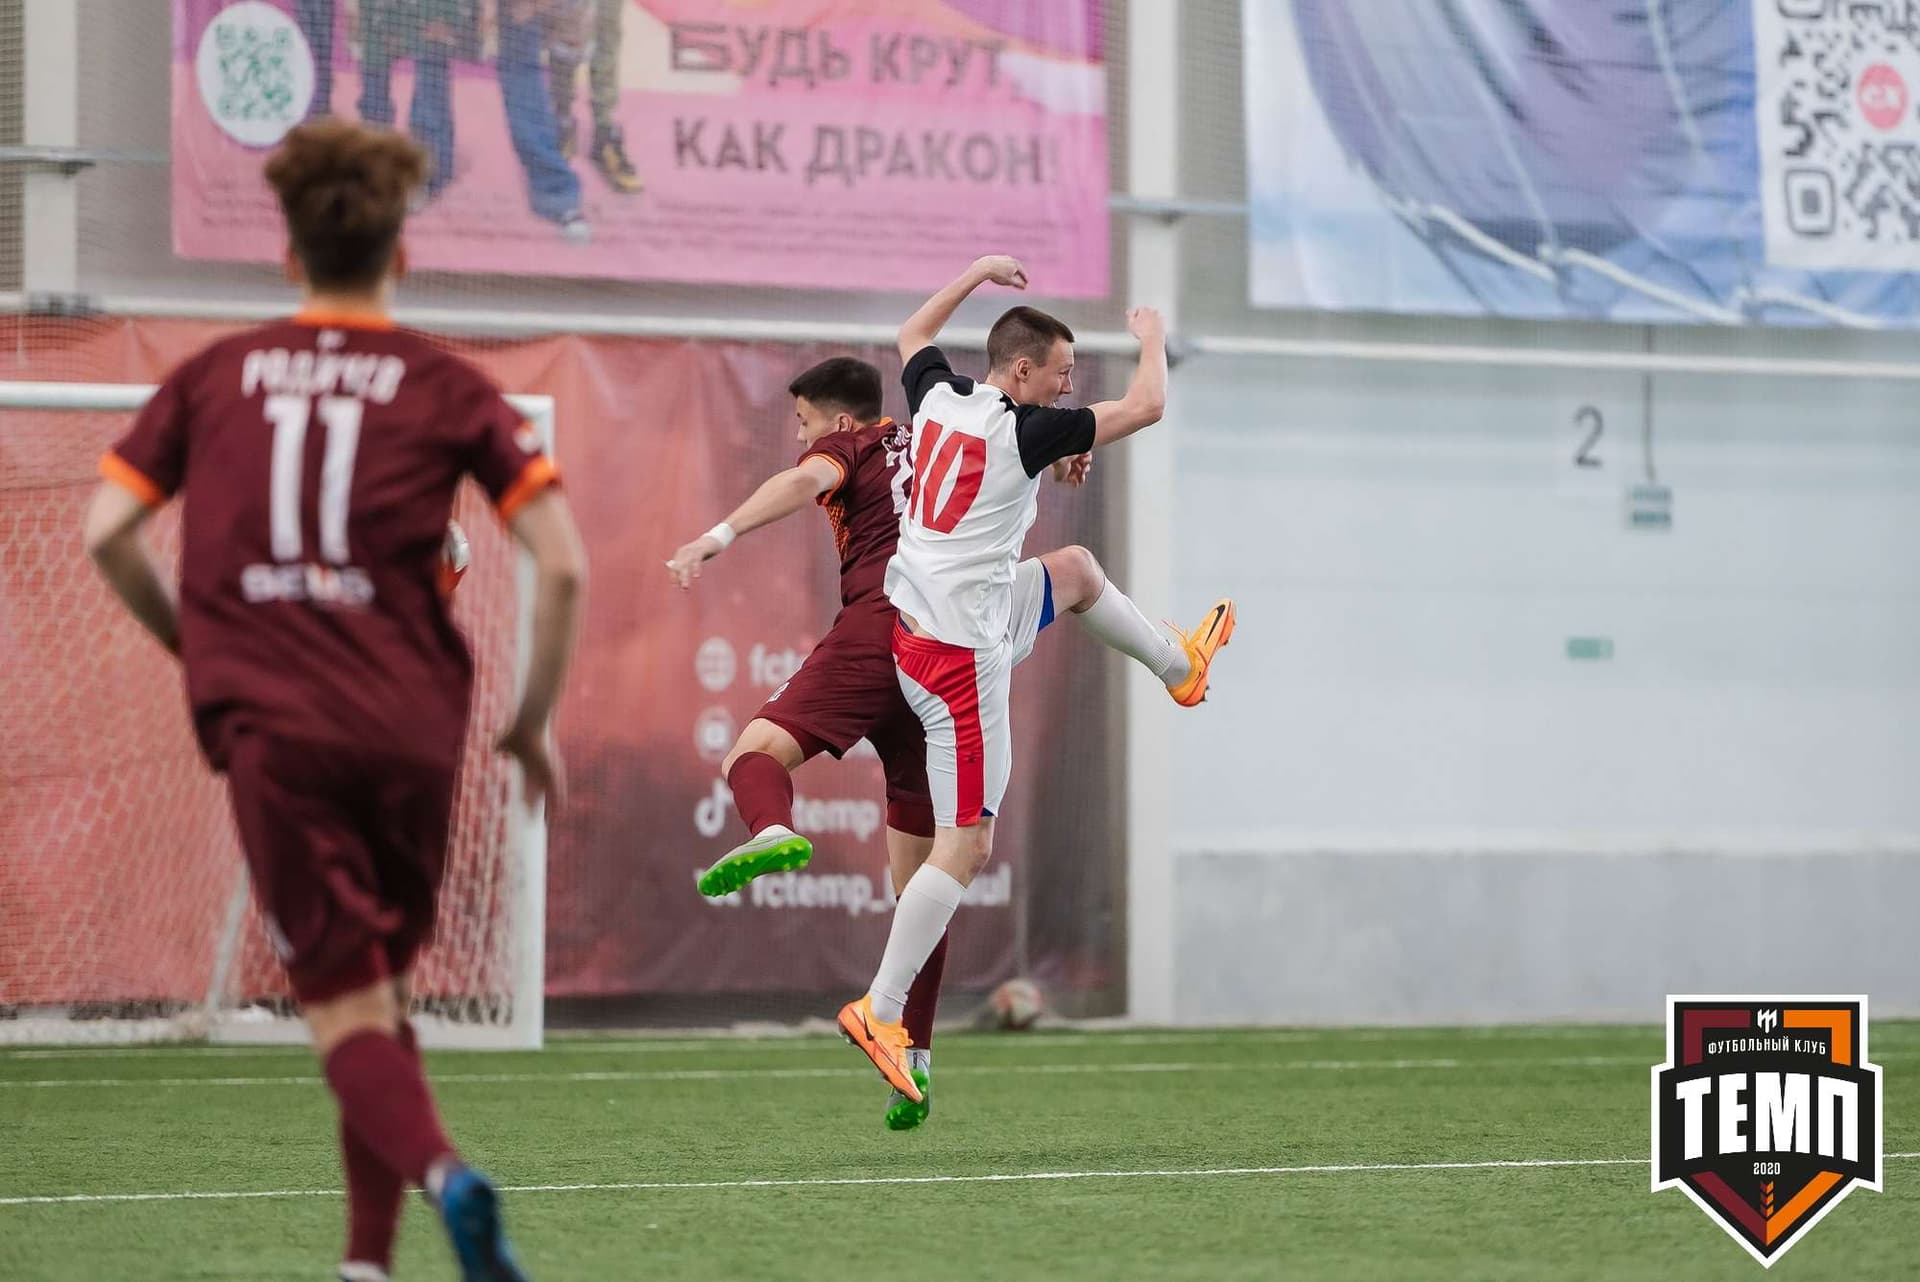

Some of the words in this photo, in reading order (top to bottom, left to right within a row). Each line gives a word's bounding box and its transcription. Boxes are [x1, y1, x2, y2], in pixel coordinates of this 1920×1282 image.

[672, 23, 850, 88] БУДЬ
[674, 118, 788, 172] КАК
[1573, 404, 1604, 467] 2
[262, 394, 365, 562] 11
[910, 419, 987, 534] 10
